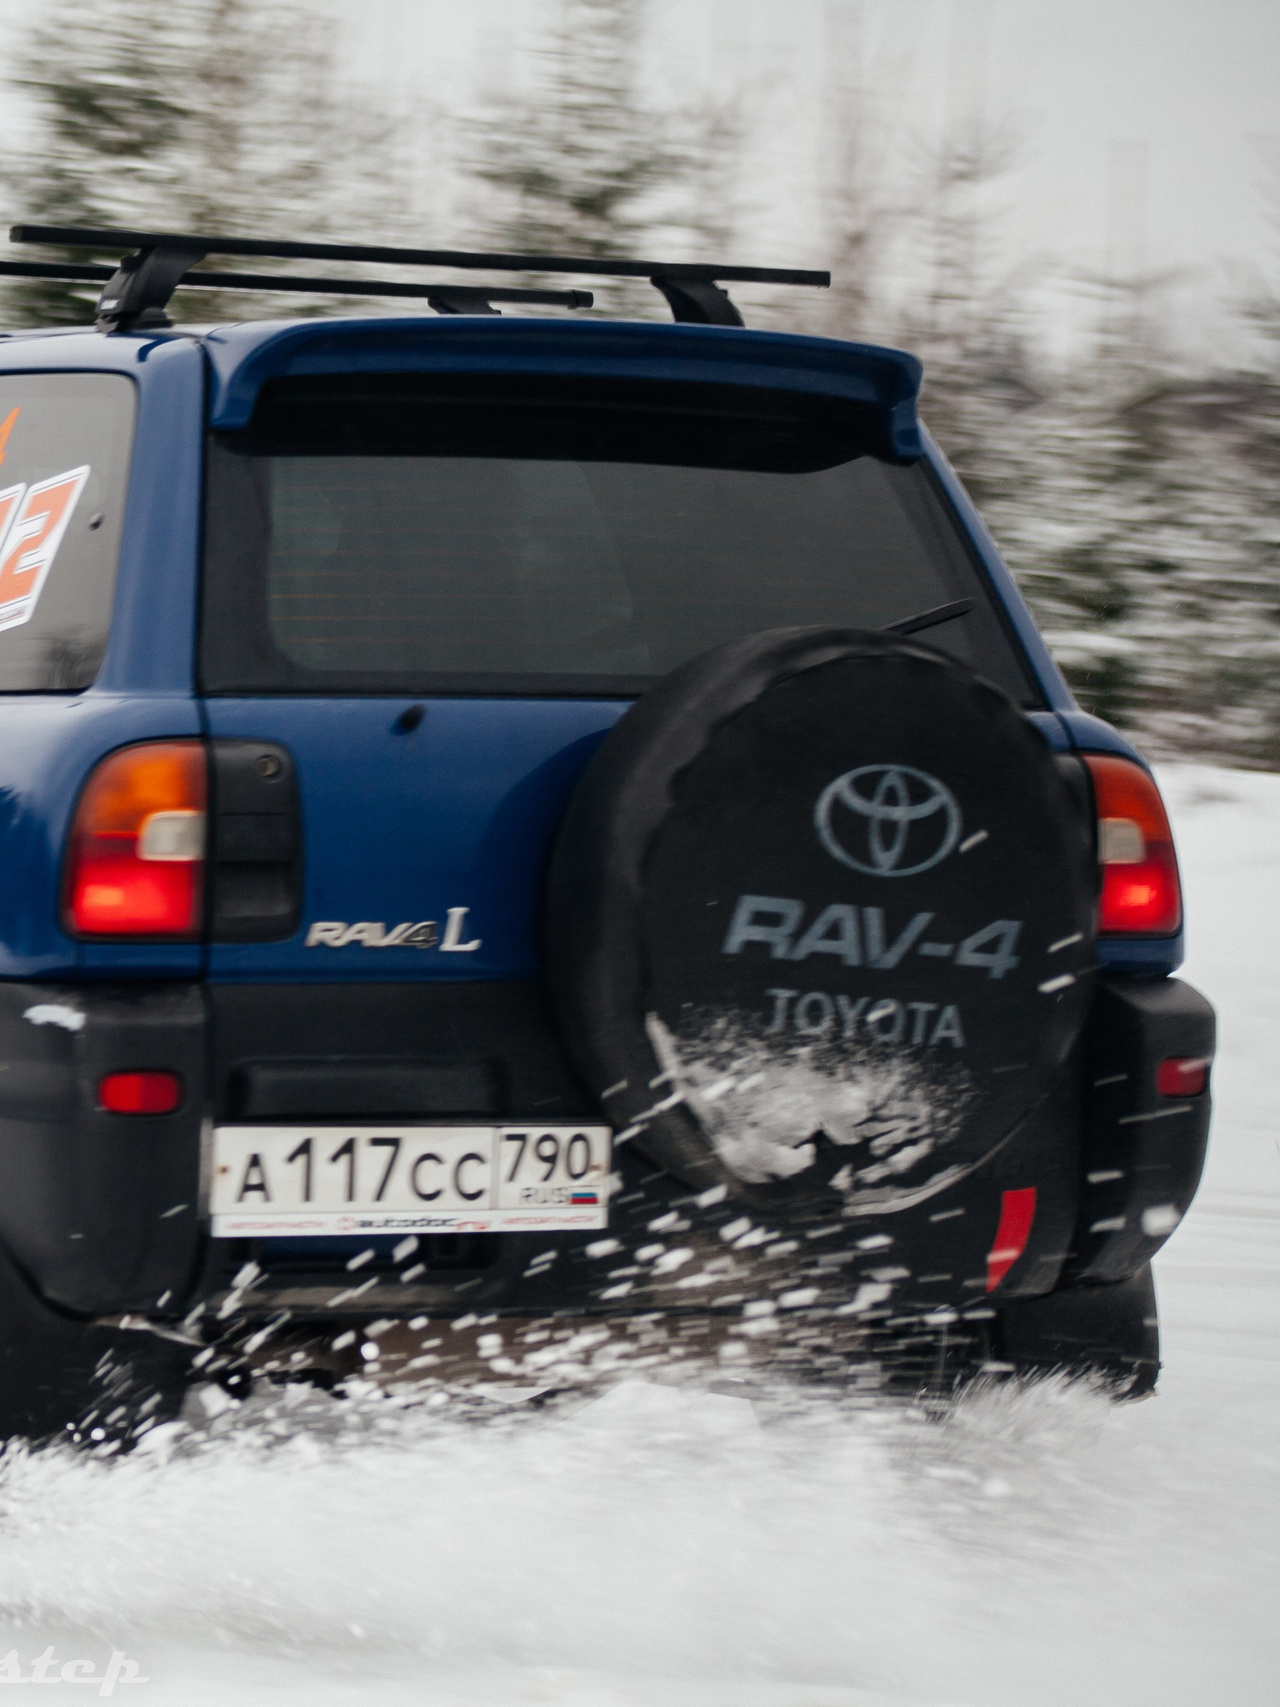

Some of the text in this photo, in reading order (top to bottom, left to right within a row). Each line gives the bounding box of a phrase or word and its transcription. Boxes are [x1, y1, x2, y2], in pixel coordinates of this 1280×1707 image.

[438, 906, 483, 952] L
[721, 894, 1024, 980] RAV-4
[764, 987, 967, 1048] TOYOTA
[500, 1132, 593, 1183] 790
[521, 1186, 570, 1205] RUS
